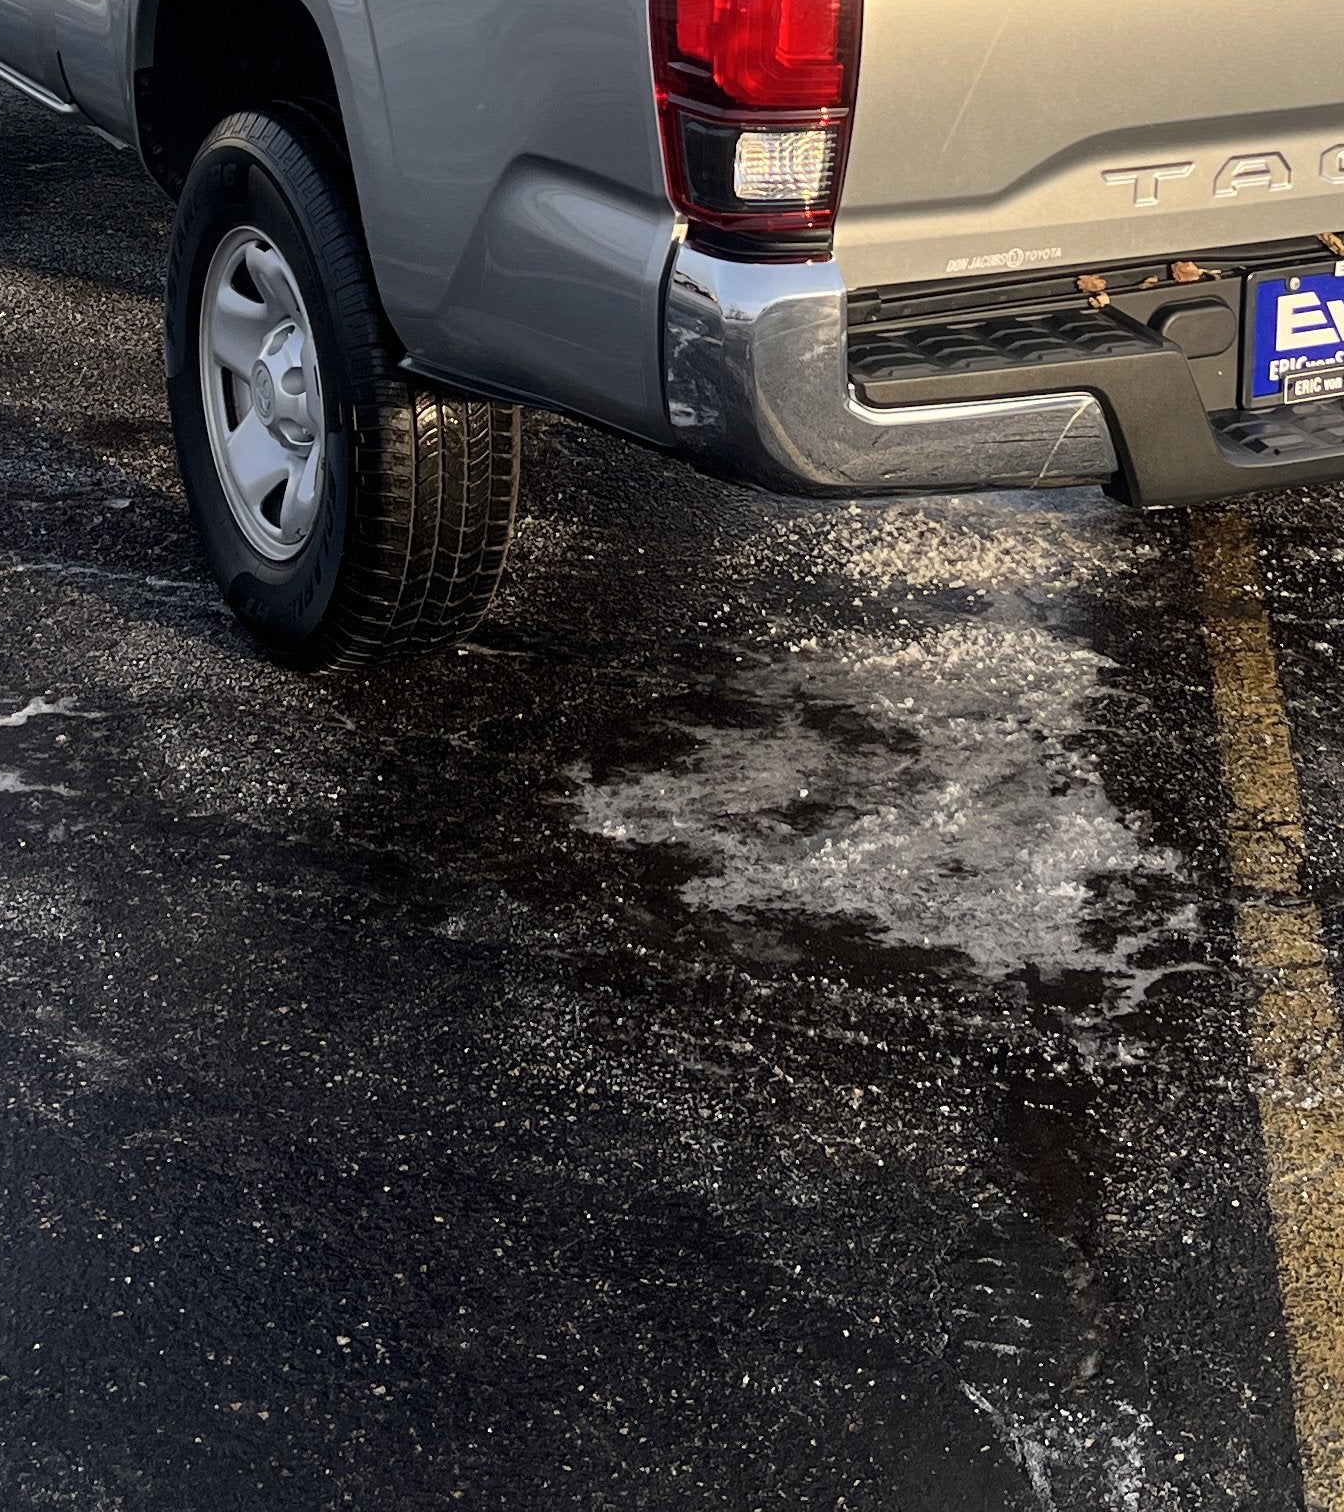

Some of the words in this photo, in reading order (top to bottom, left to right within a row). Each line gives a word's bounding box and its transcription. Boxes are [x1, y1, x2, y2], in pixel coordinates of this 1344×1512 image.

[946, 257, 969, 273] DON
[968, 252, 1008, 269] JACOBS
[1024, 247, 1062, 262] TOYOTA
[1294, 377, 1323, 396] ERIC
[1323, 377, 1343, 390] von
